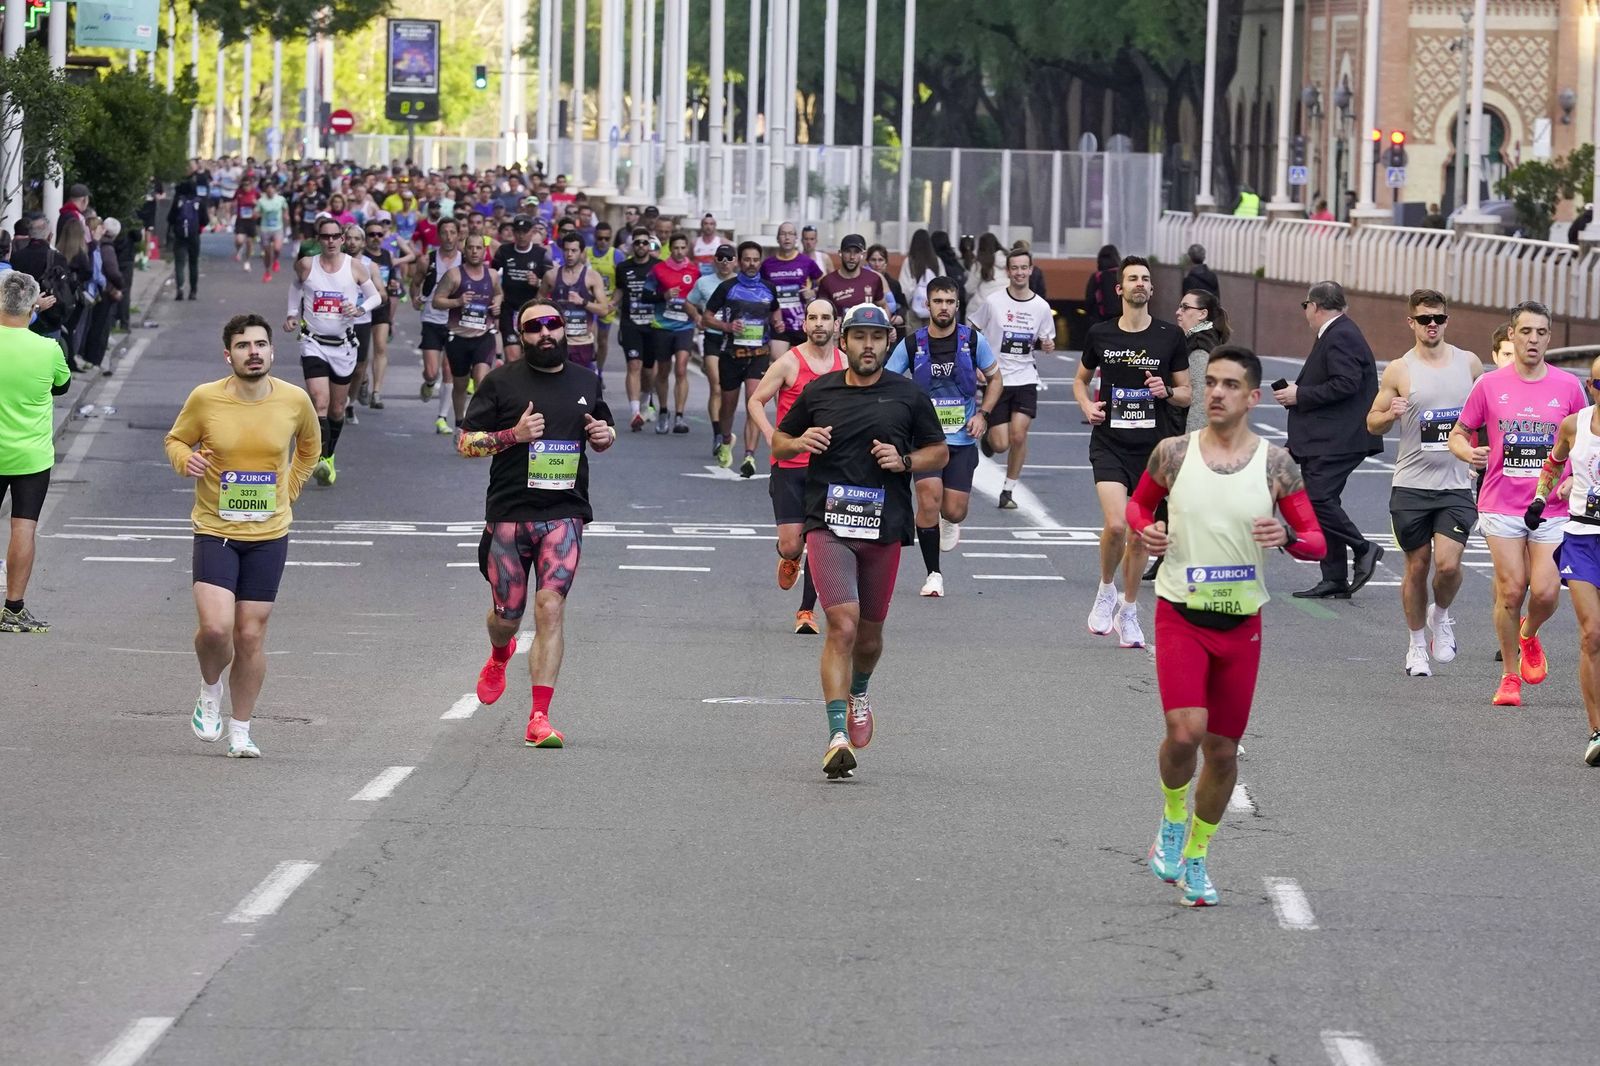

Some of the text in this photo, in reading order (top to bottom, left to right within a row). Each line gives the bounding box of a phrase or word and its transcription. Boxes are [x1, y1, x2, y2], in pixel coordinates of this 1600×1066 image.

[1103, 349, 1135, 358] Sports
[1128, 356, 1160, 366] Motion
[1121, 411, 1145, 419] JORDI
[1436, 410, 1461, 418] ZURICH
[940, 417, 965, 425] MENEZ
[1498, 420, 1558, 434] MADRID
[847, 489, 878, 498] ZURICH
[228, 499, 267, 509] CODRIN
[846, 504, 863, 513] 4500
[824, 512, 880, 527] FREDERICO
[1210, 570, 1247, 579] ZURICH
[1204, 601, 1242, 613] NEIRA
